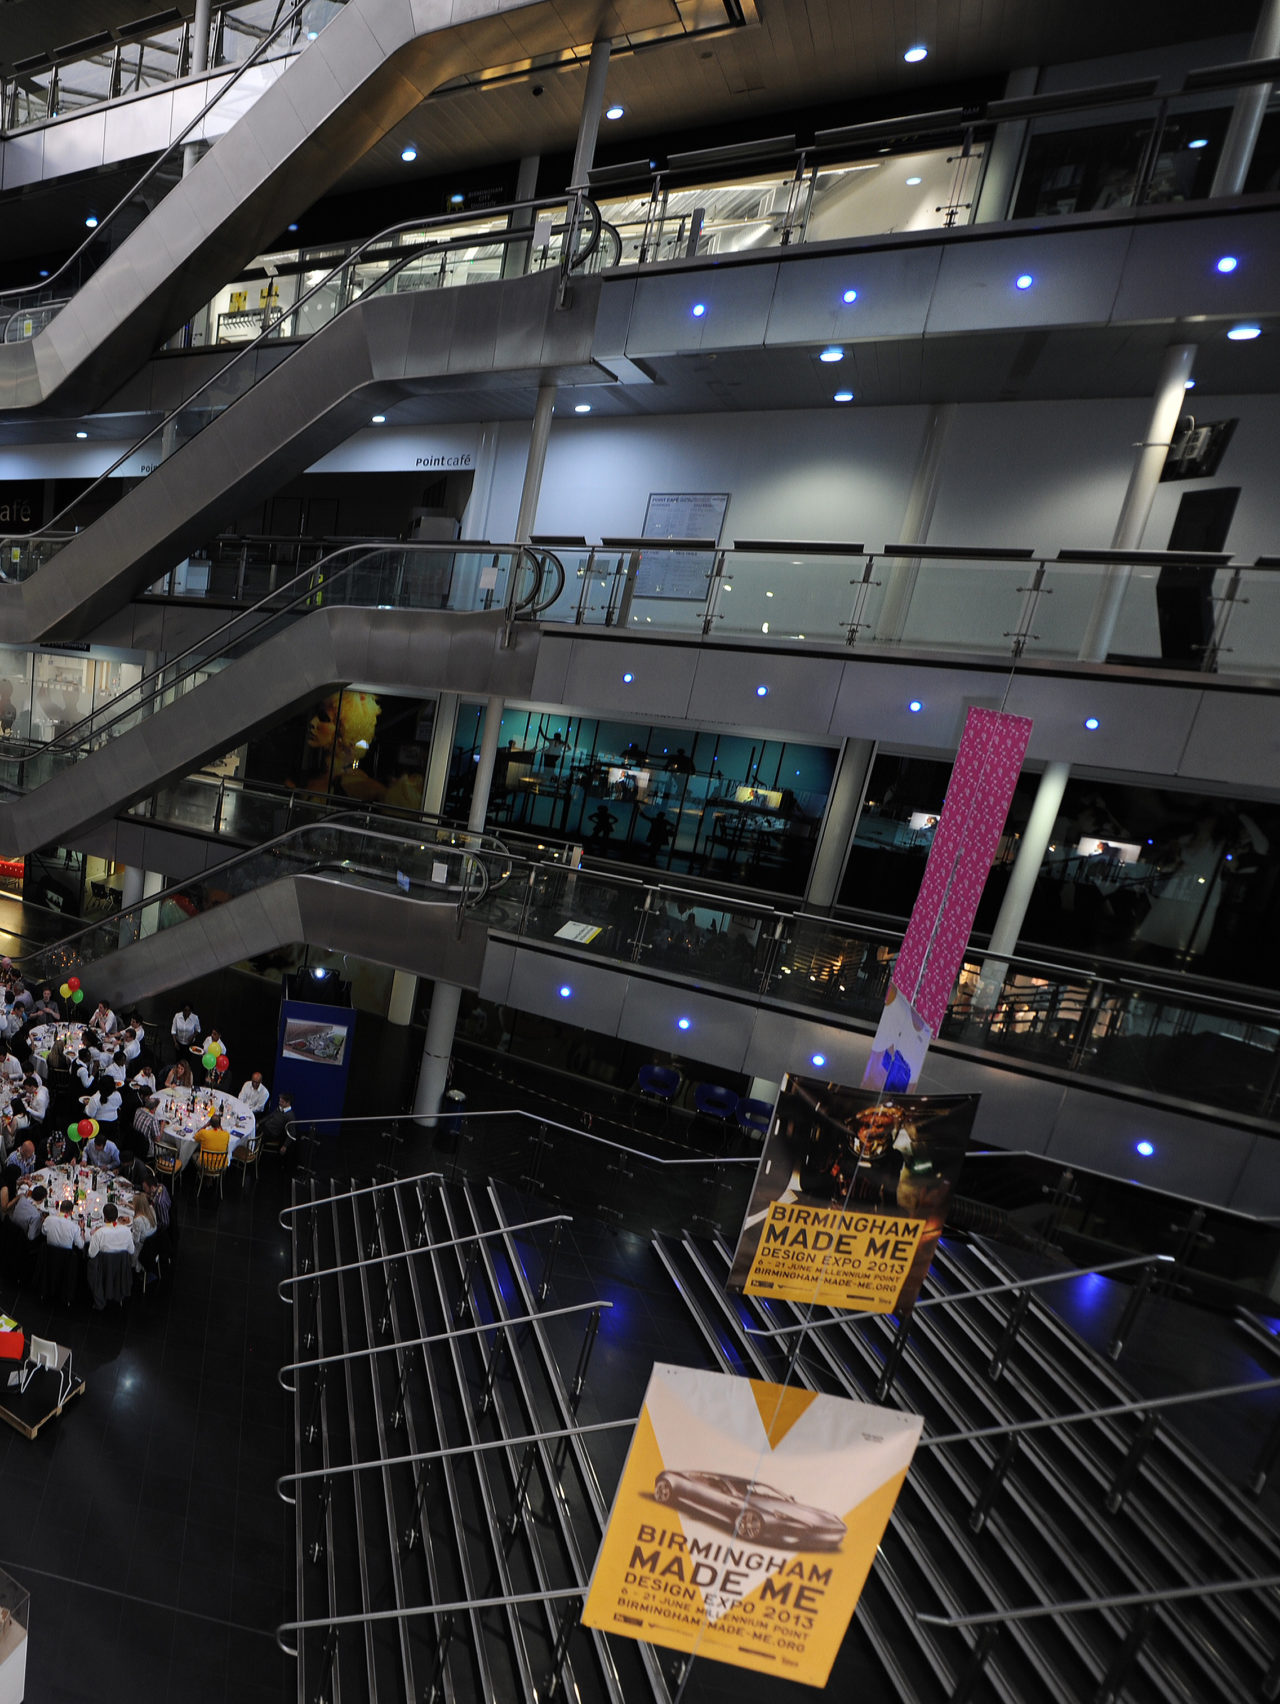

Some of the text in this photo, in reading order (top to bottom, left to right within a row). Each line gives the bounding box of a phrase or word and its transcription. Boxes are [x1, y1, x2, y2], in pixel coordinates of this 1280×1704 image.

[765, 1224, 913, 1262] MADE ME
[771, 1206, 920, 1239] BIRMINGHAM
[754, 1267, 897, 1292] BIRMINGHAMMADE-ME.ORG
[761, 1247, 905, 1275] DESIGN EXPO 2013
[787, 1264, 812, 1272] JUNE
[815, 1267, 871, 1279] MLLENNIUM
[873, 1274, 901, 1283] POINT
[637, 1524, 833, 1586] BIRMINGHAM
[624, 1572, 815, 1630] DESIGN EXPO 2013
[629, 1546, 825, 1615] MADE ME
[617, 1598, 806, 1653] BIRMINGHAMMADE-ME.ORG
[659, 1596, 691, 1611] JUNE
[774, 1625, 810, 1641] POINT
